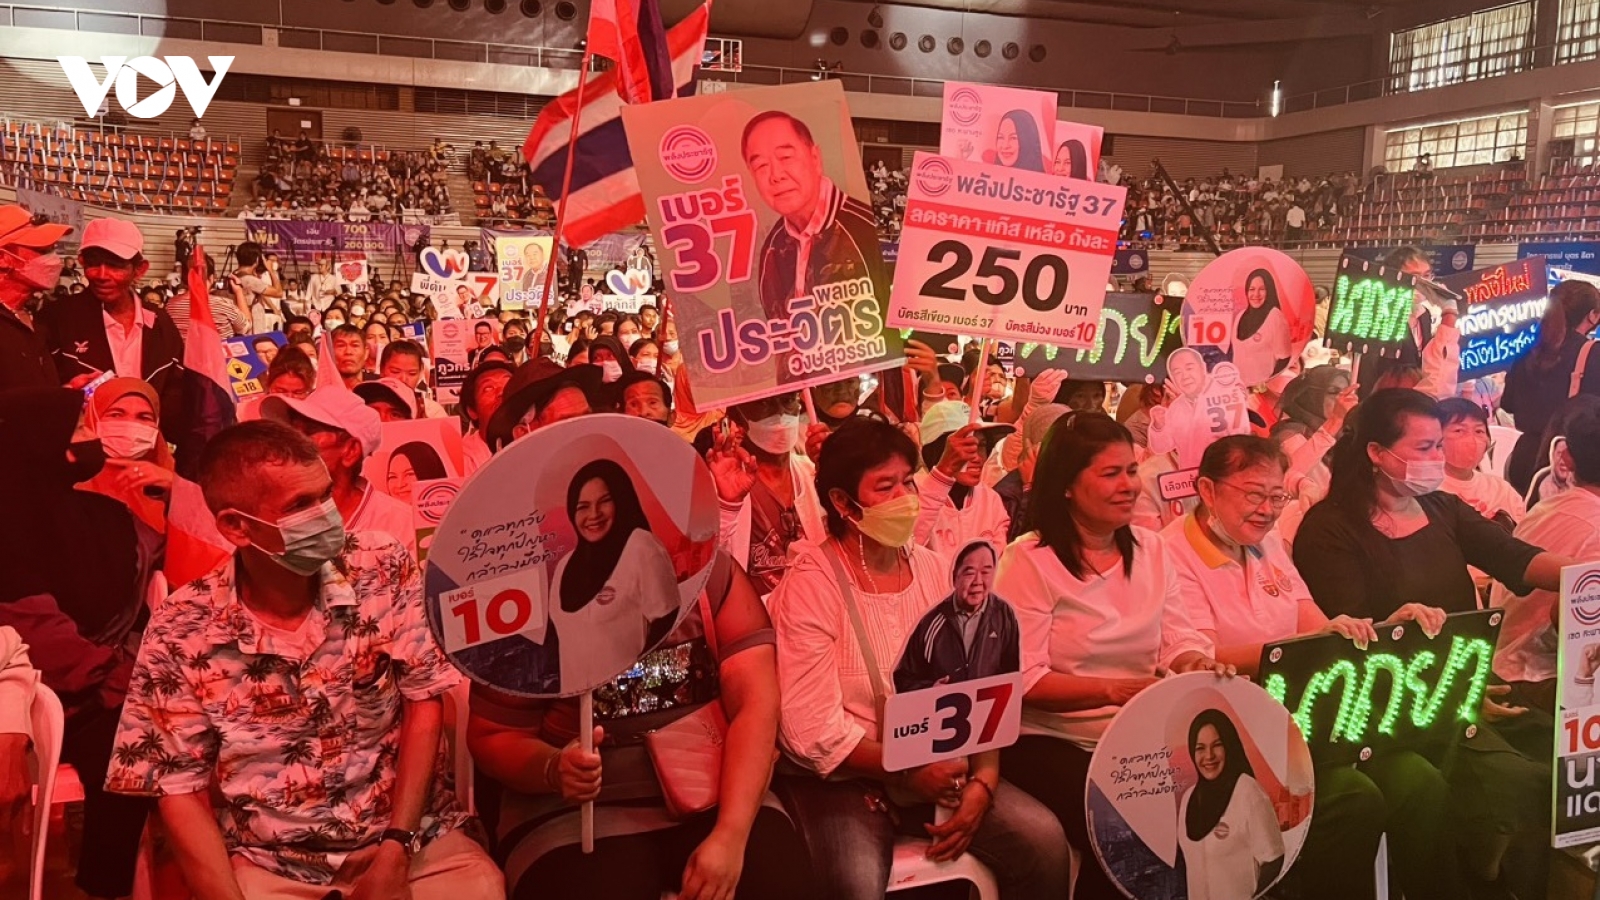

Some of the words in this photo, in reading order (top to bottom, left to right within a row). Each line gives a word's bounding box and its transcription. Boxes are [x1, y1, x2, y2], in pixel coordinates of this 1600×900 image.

[660, 178, 743, 222] เบอร์
[957, 171, 1081, 217] พลังประชารัฐ
[1083, 194, 1117, 217] 37
[343, 224, 367, 234] 700
[1025, 223, 1065, 243] เหลือ
[1069, 228, 1109, 250] ถังละ
[665, 214, 752, 289] 37
[502, 266, 524, 281] 37
[919, 240, 1069, 312] 250
[1463, 262, 1532, 304] พลังใหม่
[813, 280, 872, 306] พลเอก
[898, 306, 951, 324] บัตรสีเขียว
[953, 315, 978, 327] เบอร์
[980, 318, 993, 329] 37
[1065, 304, 1087, 317] บาท
[700, 297, 881, 370] ประวิตร
[1053, 325, 1076, 339] เบอร์
[1076, 322, 1096, 343] 10
[1193, 322, 1226, 344] 10
[790, 338, 884, 374] วงษ์สุวรรณ
[243, 381, 257, 392] 18
[1206, 392, 1239, 407] เบอร์
[1207, 403, 1244, 433] 37
[448, 587, 475, 603] เบอร์
[452, 589, 532, 645] 10
[1393, 629, 1403, 638] 10
[1271, 650, 1281, 660] 10
[893, 717, 929, 739] เบอร์
[932, 682, 1013, 754] 37
[1565, 714, 1600, 753] 10
